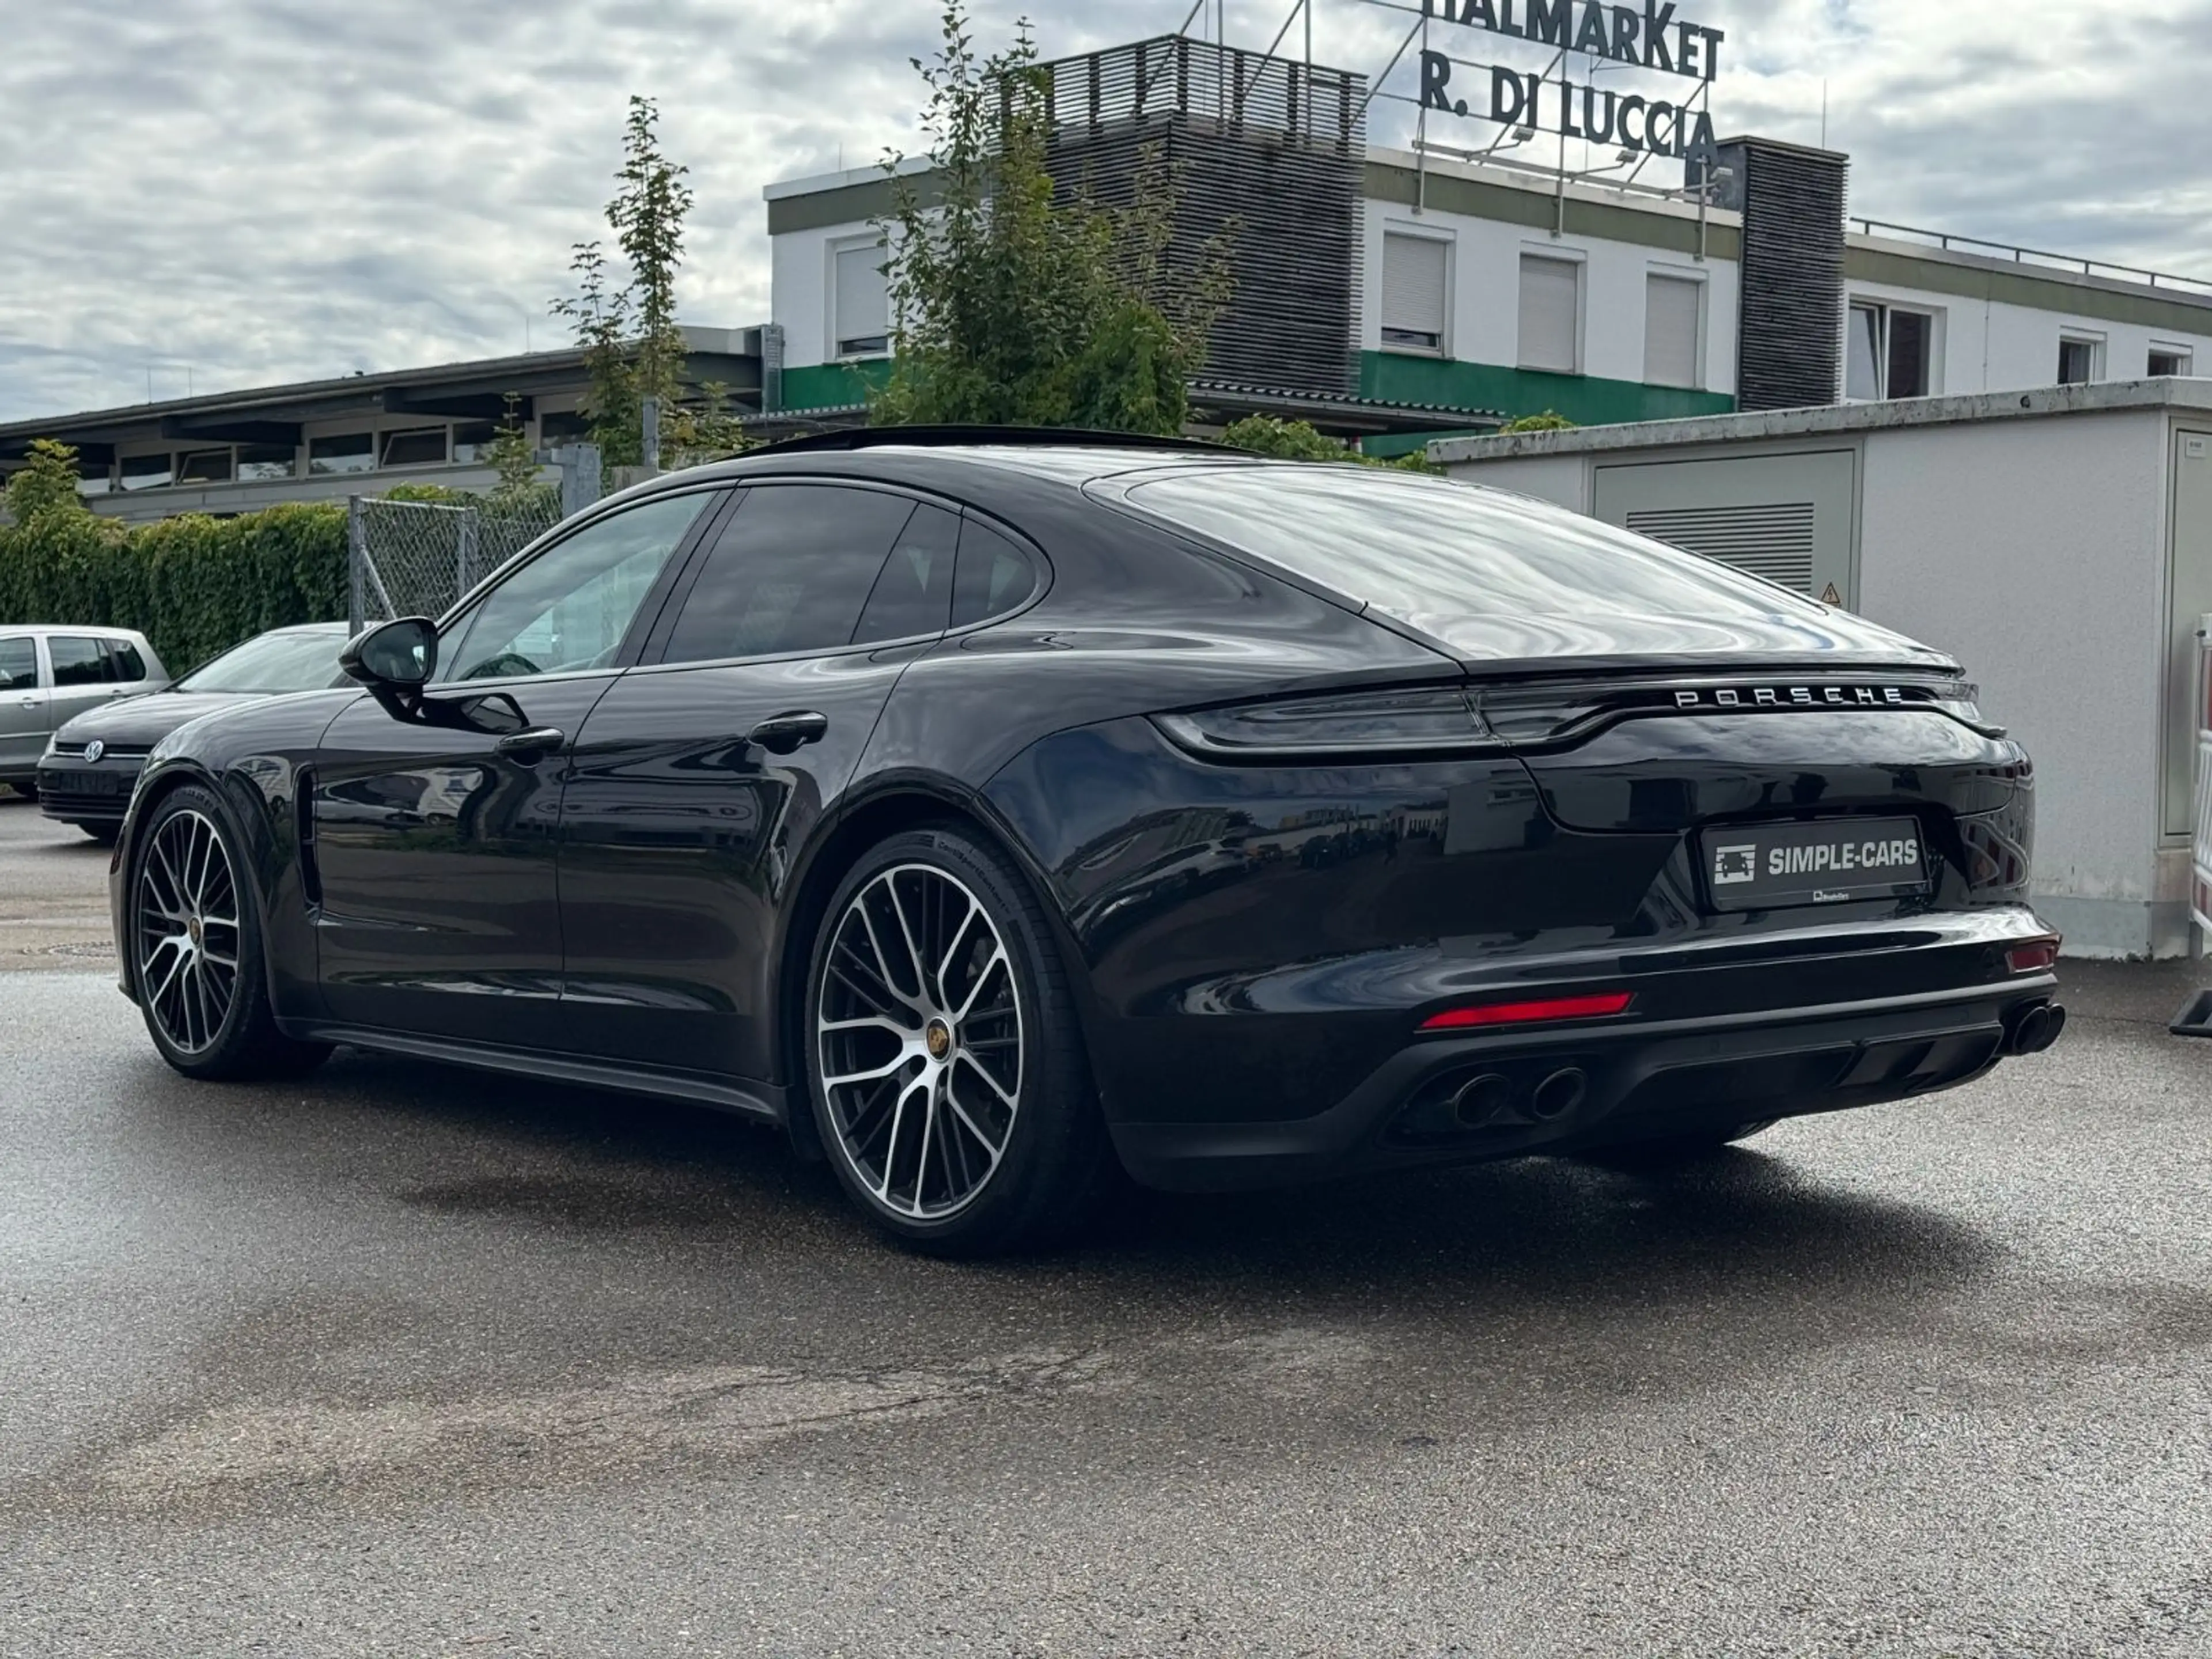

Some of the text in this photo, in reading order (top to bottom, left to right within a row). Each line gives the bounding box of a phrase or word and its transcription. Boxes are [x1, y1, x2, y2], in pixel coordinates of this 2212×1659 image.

[1421, 50, 1719, 165] R. DI LUCCIA
[1674, 687, 1902, 709] PORSCHE
